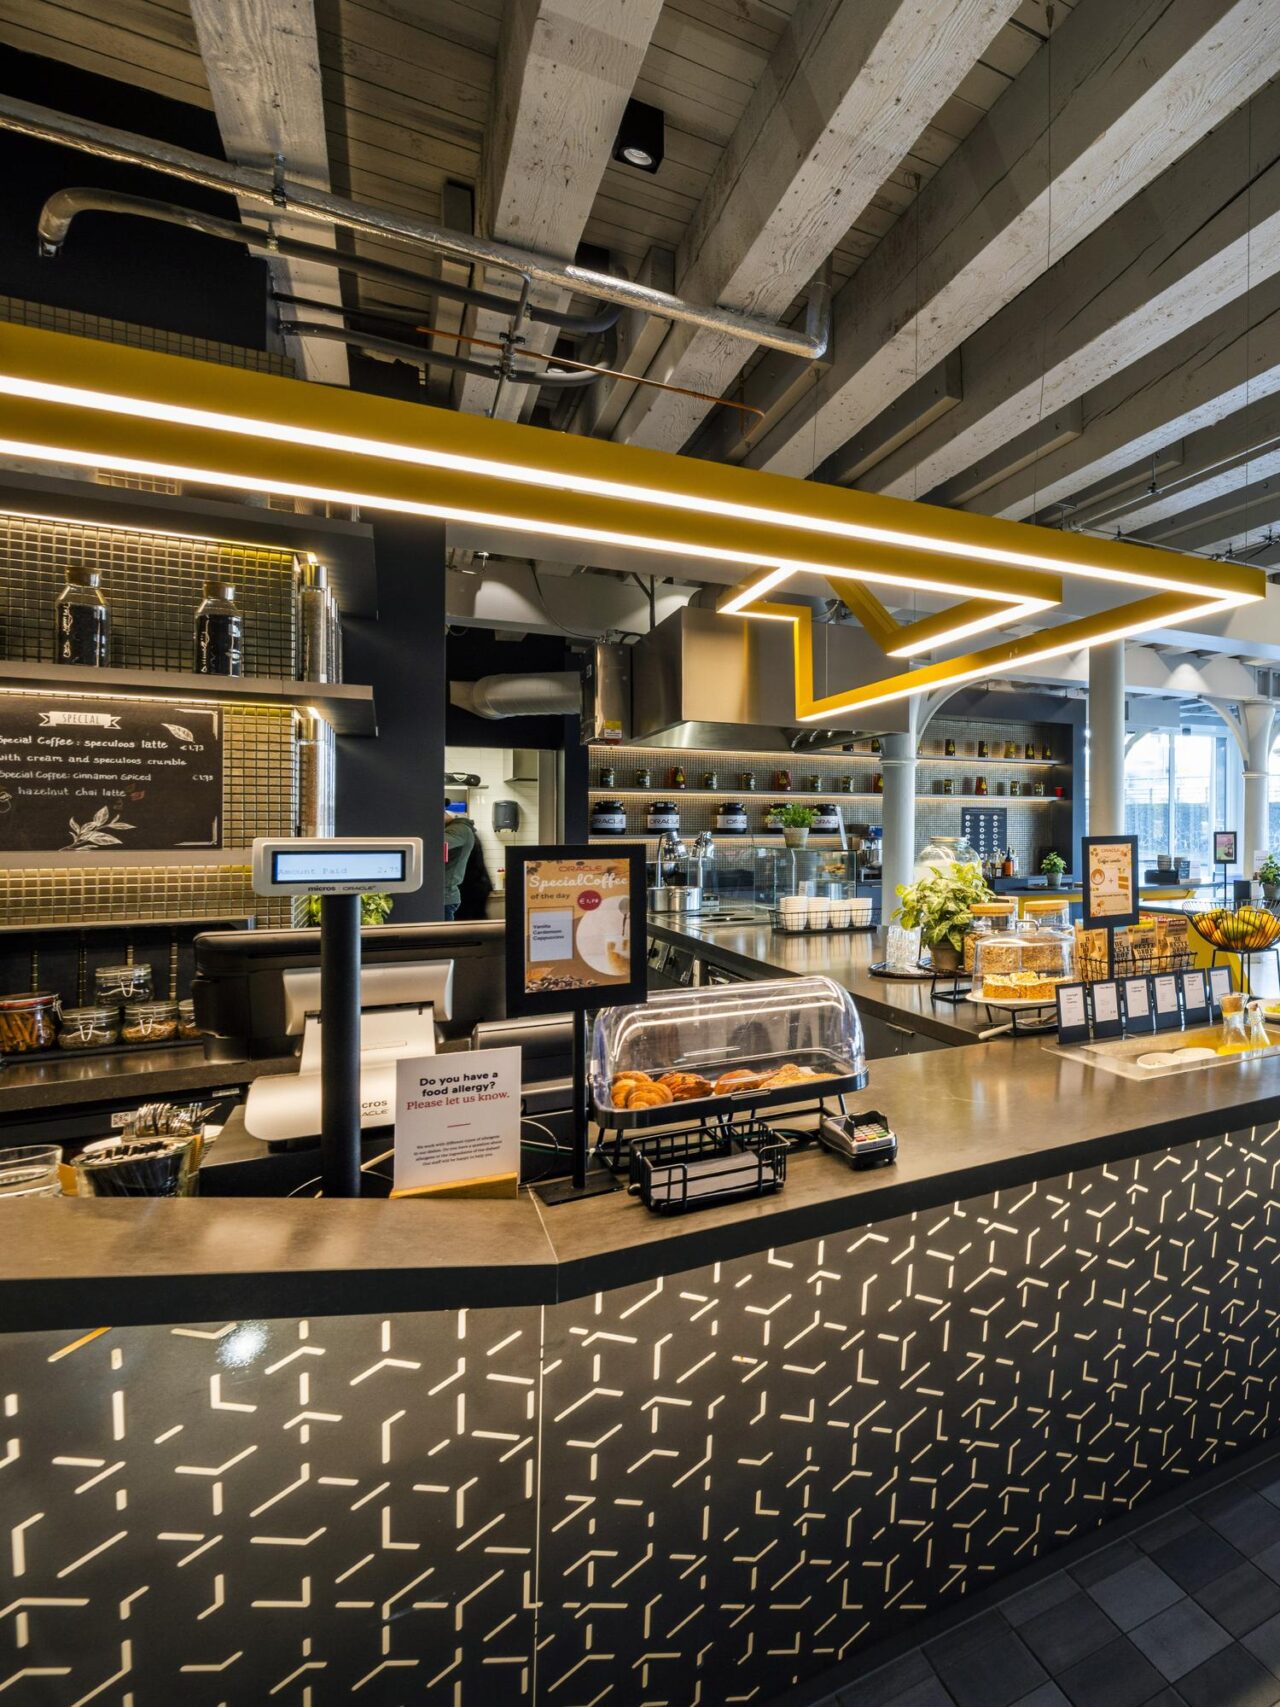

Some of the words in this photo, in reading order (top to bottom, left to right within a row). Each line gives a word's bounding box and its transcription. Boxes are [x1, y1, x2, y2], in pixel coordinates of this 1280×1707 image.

[62, 713, 100, 723] SPECIAL
[0, 735, 32, 745] Special
[84, 739, 135, 748] speculoos
[141, 739, 168, 749] latte
[68, 755, 90, 763] and
[93, 756, 142, 765] speculoos
[147, 758, 187, 766] crumble
[0, 770, 33, 779] Special
[73, 772, 118, 780] cinnamon
[18, 786, 70, 796] hazelnut
[75, 787, 98, 796] chai
[102, 788, 127, 797] latte
[558, 865, 602, 873] ORACLE
[308, 884, 336, 892] micros
[419, 1078, 436, 1086] Do
[439, 1075, 460, 1086] you
[463, 1072, 489, 1082] have
[422, 1086, 449, 1097] food
[452, 1081, 496, 1094] allergy?
[361, 1100, 388, 1109] cros
[406, 1098, 443, 1110] Please
[445, 1096, 460, 1105] let
[464, 1094, 475, 1103] us
[478, 1091, 511, 1102] know.
[361, 1109, 388, 1117] ACLE
